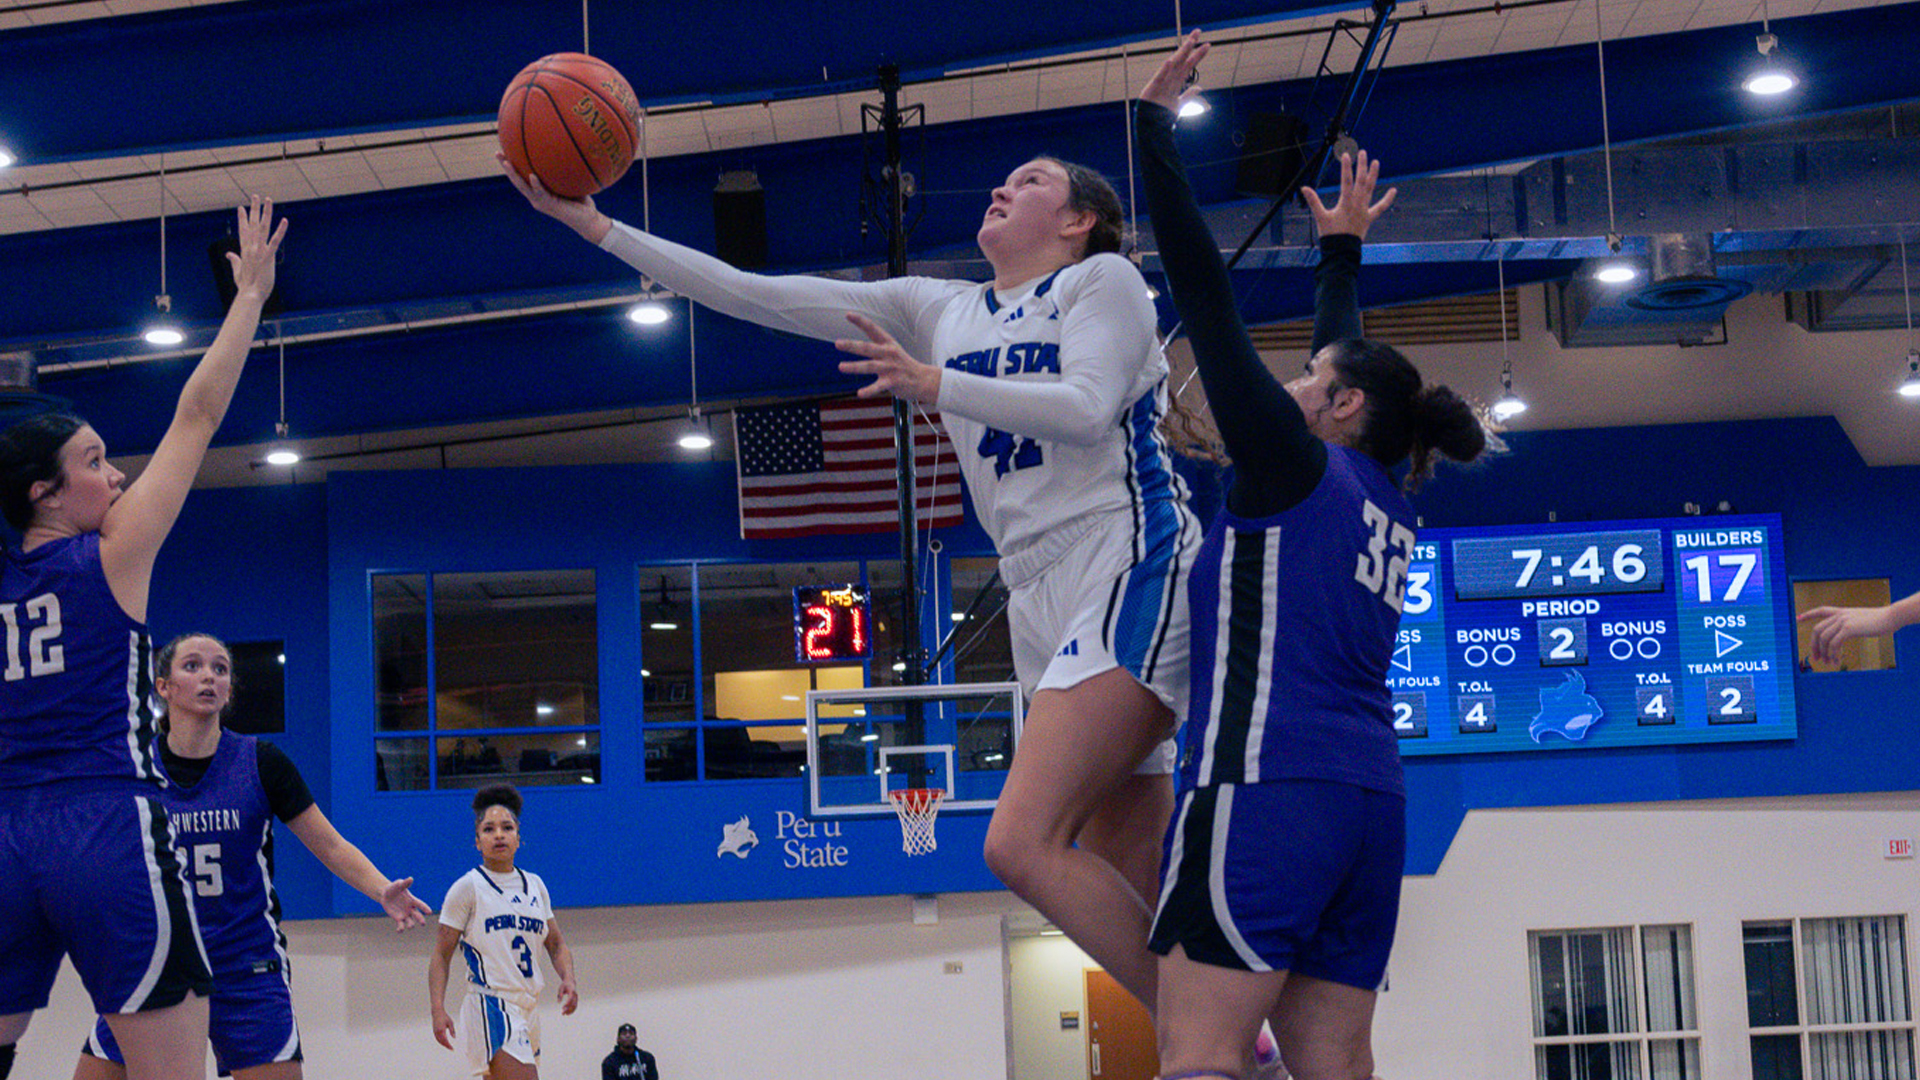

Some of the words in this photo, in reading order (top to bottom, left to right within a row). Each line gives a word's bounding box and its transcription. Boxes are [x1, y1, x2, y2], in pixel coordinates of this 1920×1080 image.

[1004, 341, 1061, 376] STA
[1675, 530, 1763, 548] BUILDERS
[1354, 498, 1416, 616] 32
[1511, 543, 1646, 588] 7:46
[1685, 553, 1757, 603] 17
[1403, 572, 1433, 614] 3
[1522, 599, 1600, 618] PERIOD
[1703, 614, 1747, 629] POSS
[0, 592, 65, 682] 12
[806, 606, 861, 657] 21
[1395, 629, 1422, 644] SS
[1456, 627, 1522, 644] BONUS
[1601, 620, 1667, 637] BONUS
[1549, 626, 1576, 660] 2
[1635, 672, 1672, 686] T.O.L
[1687, 663, 1723, 675] TEAM
[1726, 660, 1770, 673] FOULS
[1399, 675, 1441, 688] FOULS
[1457, 680, 1493, 693] T.O.L
[1643, 694, 1667, 719] 4
[1719, 687, 1743, 715] 2
[1392, 702, 1414, 730] 2
[1464, 702, 1488, 727] 4
[172, 808, 240, 834] HWESTERN
[775, 811, 842, 840] Peru
[784, 838, 849, 869] State
[1889, 839, 1908, 855] EXIT
[511, 935, 534, 978] 3
